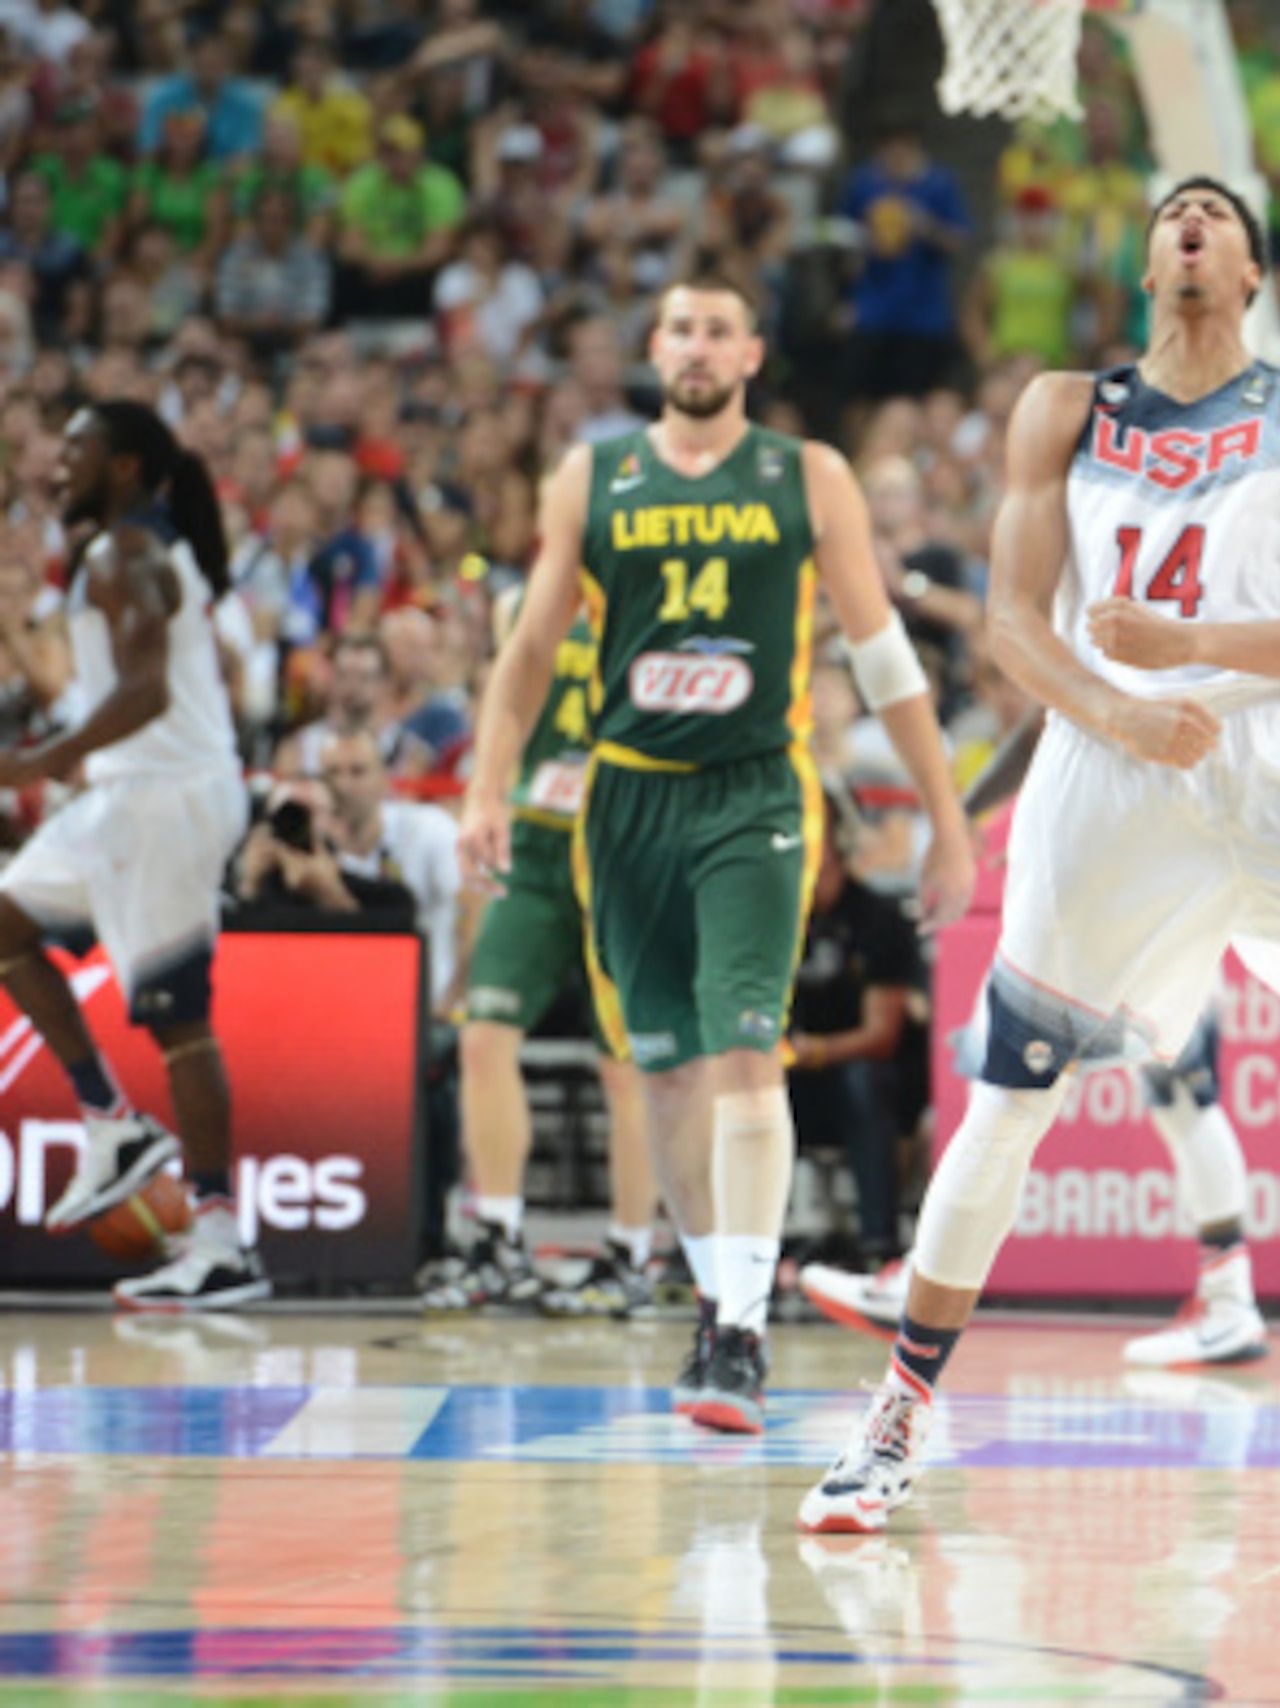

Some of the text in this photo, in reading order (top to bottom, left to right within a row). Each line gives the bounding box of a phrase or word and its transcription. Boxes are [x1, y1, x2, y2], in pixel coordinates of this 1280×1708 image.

[1092, 413, 1265, 493] USA
[611, 500, 781, 551] LIETUVA
[658, 556, 731, 622] 14
[1112, 522, 1207, 619] 14
[643, 665, 741, 701] VICI
